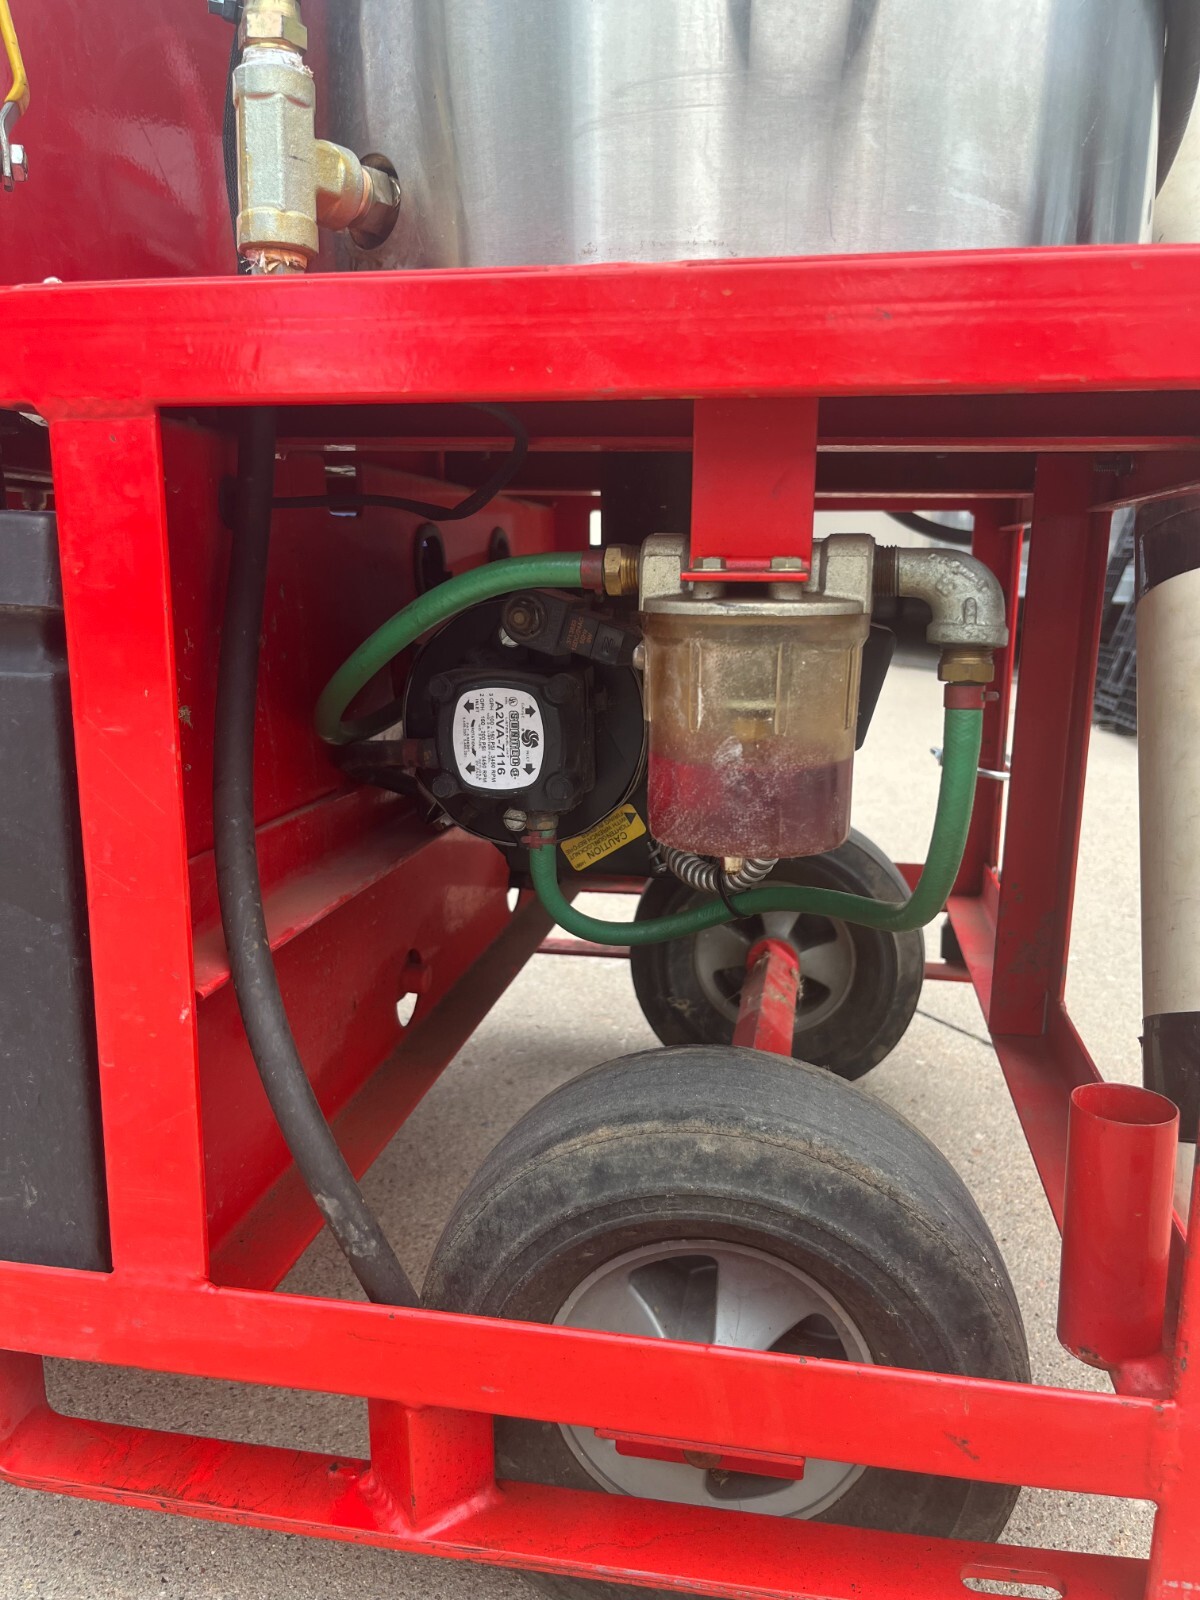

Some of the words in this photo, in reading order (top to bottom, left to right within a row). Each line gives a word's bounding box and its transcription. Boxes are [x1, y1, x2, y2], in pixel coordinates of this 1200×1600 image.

[495, 702, 506, 775] A2VA-7116
[606, 822, 630, 839] TIGHTEN
[612, 816, 627, 828] WITH
[587, 825, 612, 842] WRENCH
[586, 832, 627, 859] CAUTION
